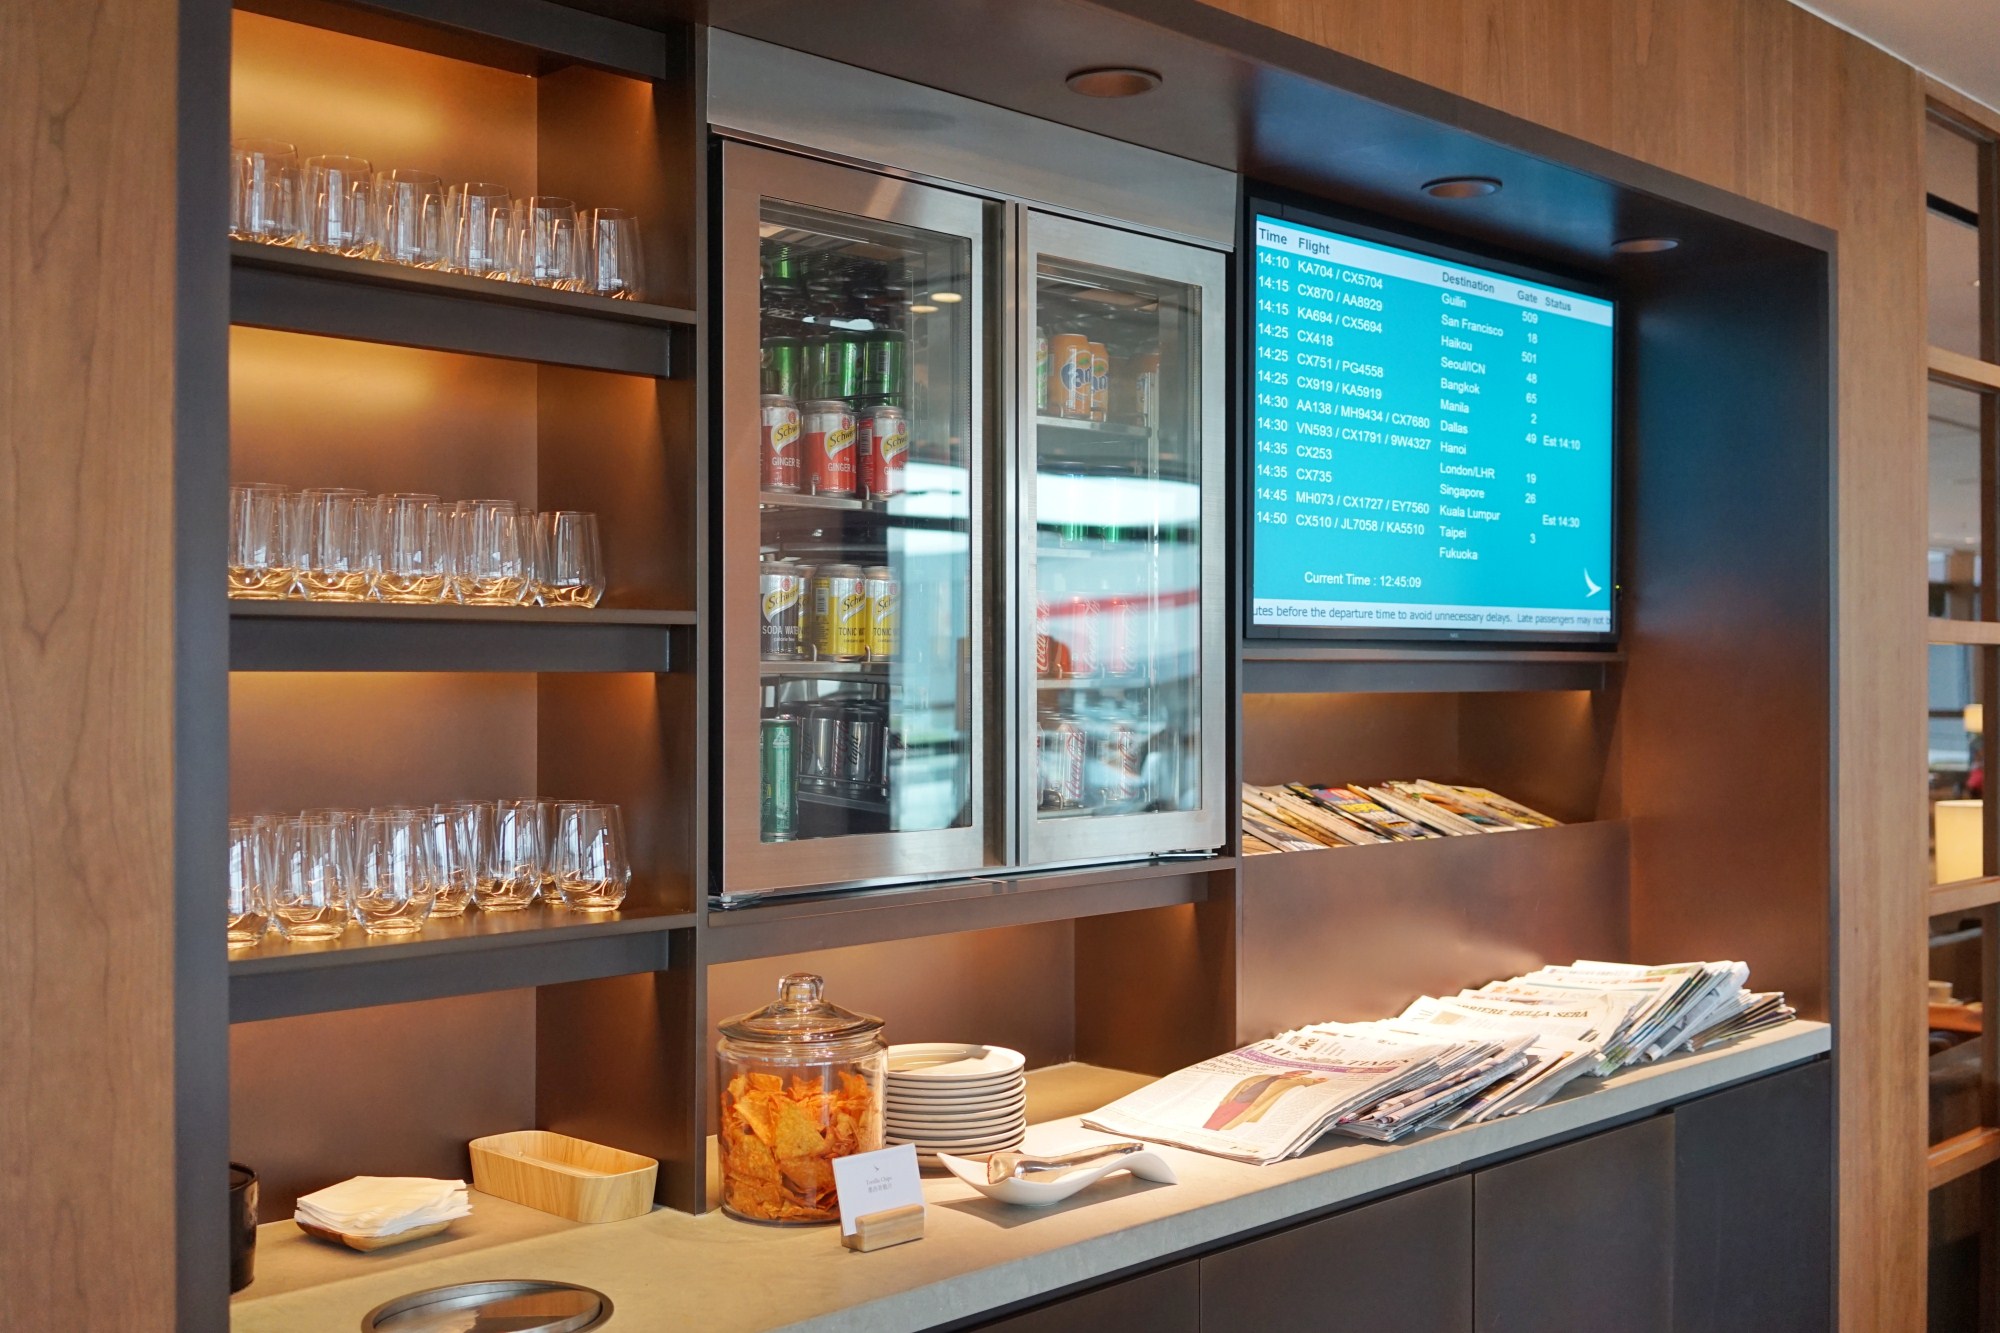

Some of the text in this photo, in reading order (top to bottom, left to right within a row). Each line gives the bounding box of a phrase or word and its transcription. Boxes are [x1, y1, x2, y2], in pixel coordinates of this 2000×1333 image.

[1258, 227, 1572, 312] Time Flight Destination Gate Status
[1258, 252, 1289, 269] 14:10
[1298, 258, 1334, 278] KA704
[1342, 270, 1383, 289] CX5704
[1441, 293, 1466, 308] Guilin
[1522, 311, 1538, 324] 509
[1259, 276, 1289, 292] 14:15
[1298, 284, 1334, 301] CX870
[1342, 294, 1382, 311] AA8929
[1441, 314, 1459, 327] San
[1462, 318, 1503, 336] Francisco
[1528, 333, 1537, 344] 18
[1259, 299, 1289, 315] 14:15
[1298, 307, 1333, 323] KA694
[1342, 316, 1382, 333] CX5694
[1441, 336, 1472, 351] Haikou
[1522, 351, 1536, 363] 501
[1258, 323, 1537, 384] 14:25 CX418 Seoul/ICN 48
[1258, 346, 1288, 362] 14:25
[1297, 353, 1332, 369] CX751
[1342, 361, 1383, 378] PG4558
[1441, 377, 1479, 394] Bangkok
[1526, 393, 1537, 403] 65
[1258, 370, 1288, 385] 14:25
[1297, 376, 1333, 392] CX919
[1342, 383, 1382, 399] KA5919
[1440, 399, 1469, 413] Manila
[1531, 413, 1537, 424] 2
[1258, 393, 1288, 408] 14:30
[1296, 399, 1332, 414] AA138
[1341, 405, 1383, 421] MH9434
[1392, 413, 1430, 428] CX7680
[1440, 420, 1468, 434] Dallas
[1526, 433, 1537, 444] 49
[1543, 435, 1557, 446] Est
[1559, 438, 1580, 450] 14:10
[1258, 417, 1288, 431] 14:30
[1296, 422, 1332, 437] VN593
[1342, 428, 1381, 443] CX1791
[1391, 435, 1431, 449] 9W4327
[1440, 442, 1466, 454] Hanoi
[772, 457, 795, 467] GINGER
[828, 462, 851, 472] GINGER
[1258, 441, 1536, 484] 14:35 CX253 London/LHR 19
[1258, 464, 1536, 503] 14:35 CX735 Singapore 26
[1257, 488, 1287, 501] 14:45
[1296, 491, 1334, 505] MH073
[1343, 496, 1383, 509] CX1727
[1392, 500, 1429, 514] EY7560
[1440, 505, 1465, 517] Kuala
[1467, 508, 1500, 521] Lumpur
[1543, 514, 1556, 525] Est
[1558, 517, 1580, 528] 14:30
[1257, 511, 1287, 524] 14:50
[1296, 514, 1332, 528] CX510
[1341, 518, 1378, 531] JL7058
[1387, 522, 1424, 535] KA5510
[1439, 526, 1466, 539] Taipei
[1530, 533, 1536, 544] 3
[1439, 547, 1478, 560] Fukuoka
[1304, 572, 1343, 584] Current
[1345, 573, 1370, 585] Time
[1380, 576, 1421, 588] 12:45:09
[762, 625, 783, 635] SODA
[838, 627, 857, 636] TONIC
[1276, 604, 1308, 618] before
[1310, 606, 1327, 618] the
[1329, 606, 1373, 621] departure
[1376, 608, 1396, 620] time
[1398, 609, 1408, 621] to
[1409, 609, 1433, 622] avoid
[1434, 611, 1484, 625] unnecessary
[1486, 611, 1513, 625] delays.
[1517, 612, 1533, 624] Late
[1535, 615, 1575, 627] passengers
[1576, 615, 1592, 627] may
[1593, 615, 1604, 625] not
